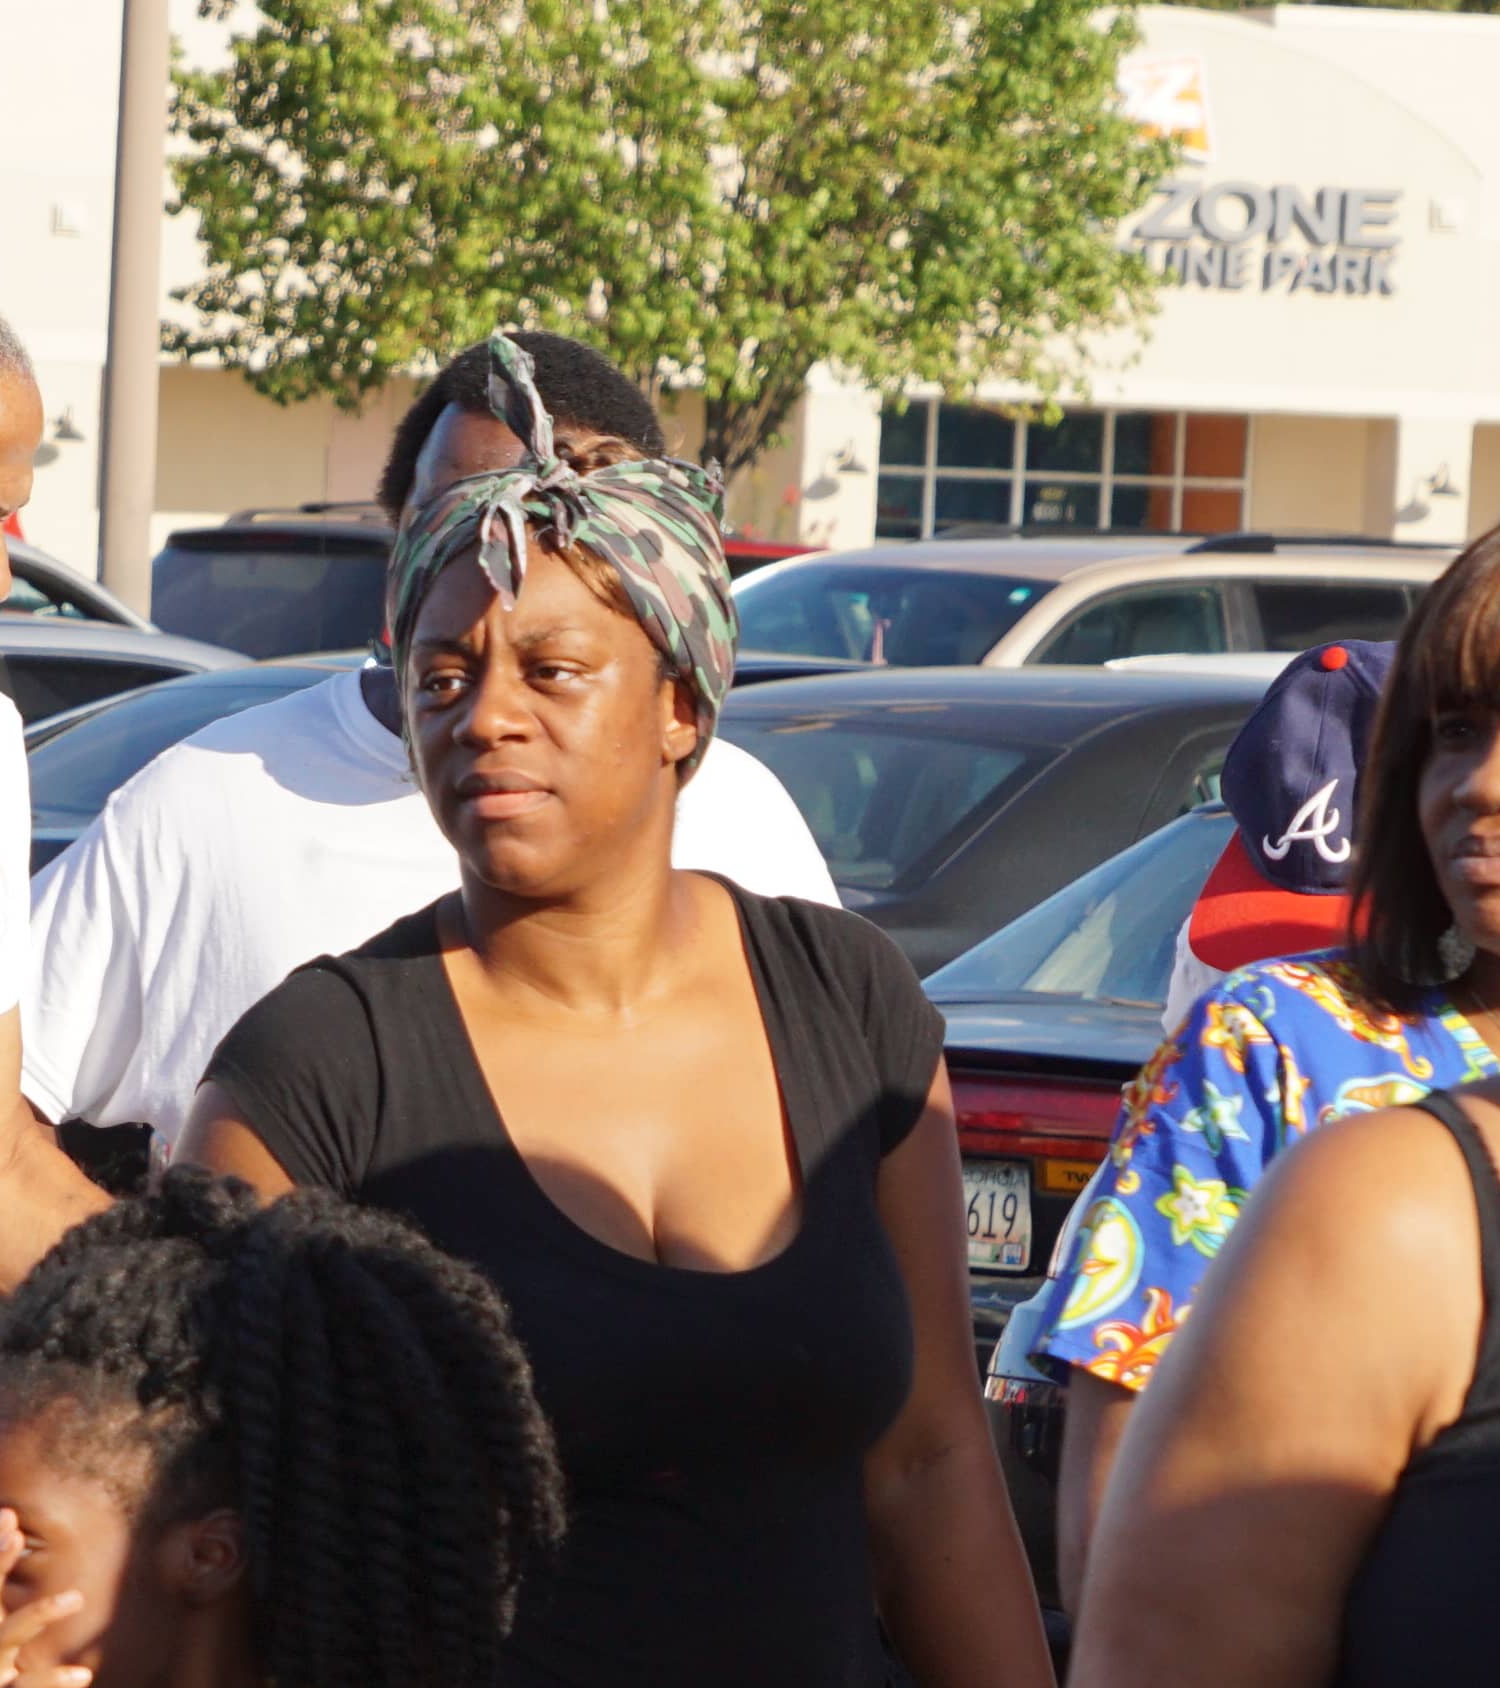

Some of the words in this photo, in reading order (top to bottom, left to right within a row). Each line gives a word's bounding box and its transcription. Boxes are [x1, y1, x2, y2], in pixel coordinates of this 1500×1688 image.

[1134, 181, 1402, 248] ZONE
[1261, 251, 1397, 296] PARK
[1263, 779, 1350, 863] A
[967, 1190, 1018, 1240] 619
